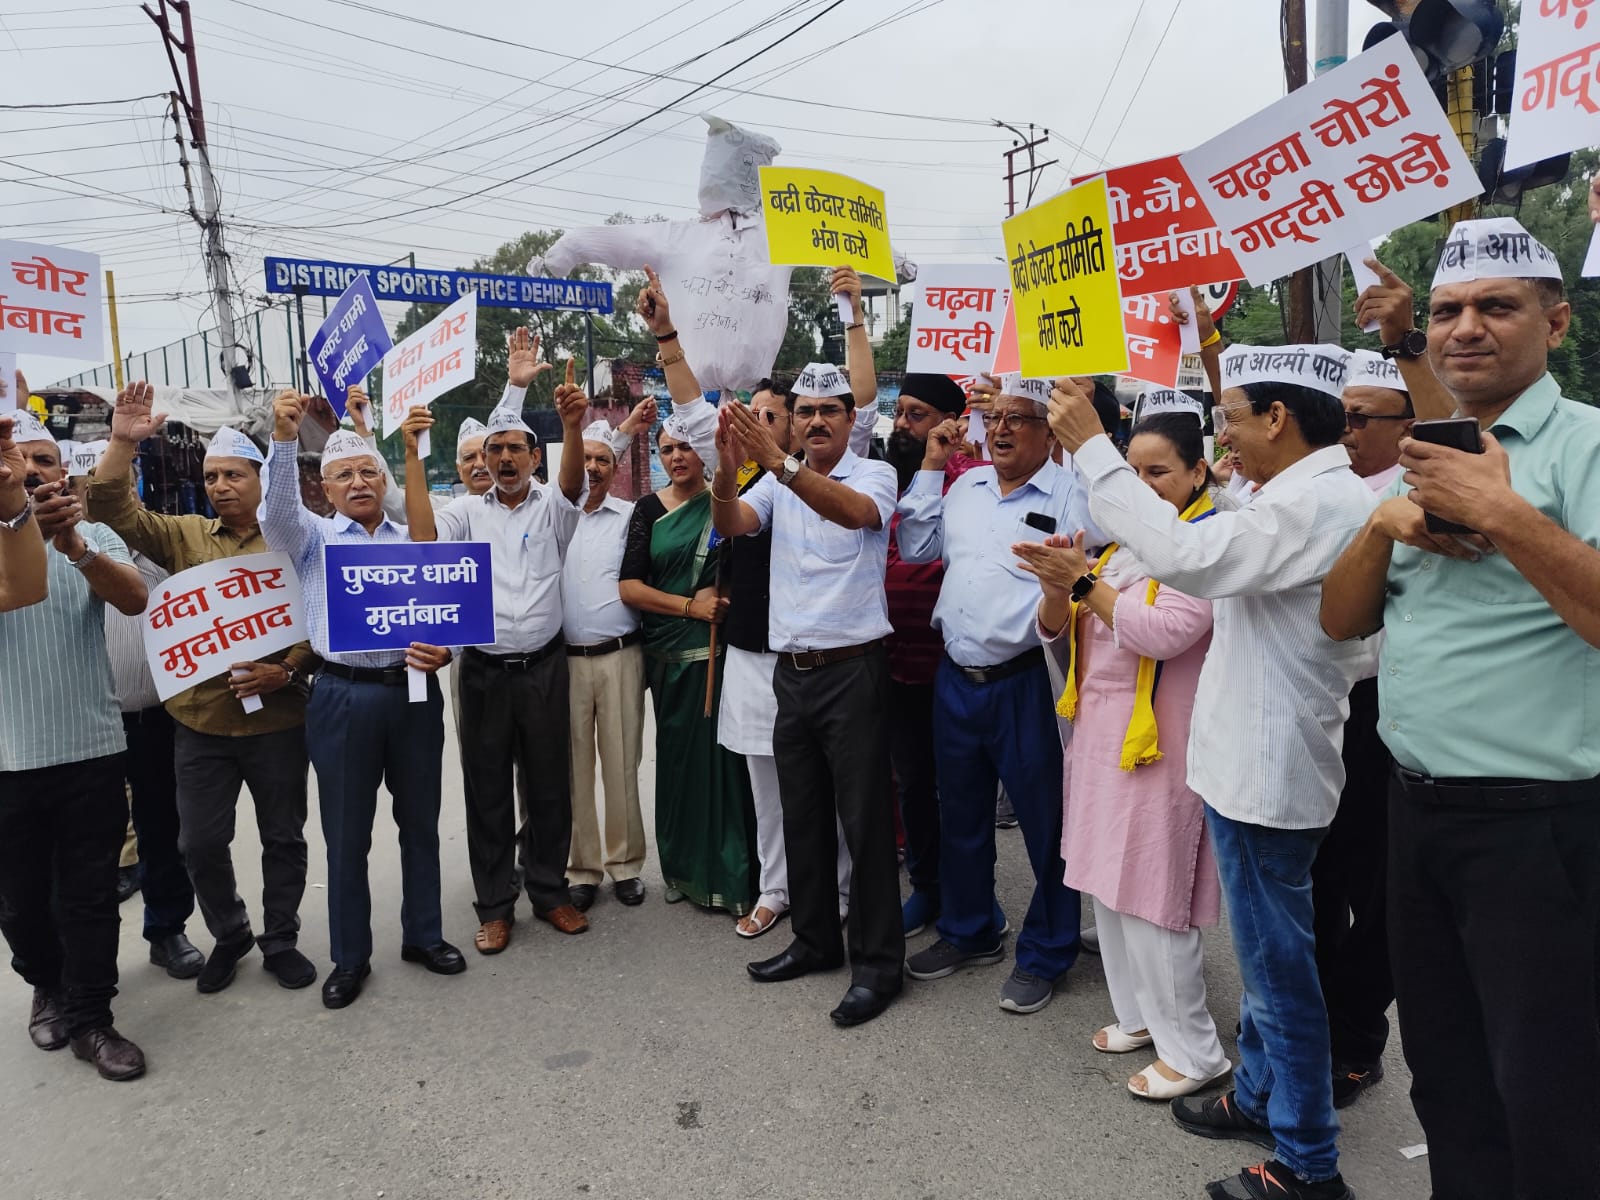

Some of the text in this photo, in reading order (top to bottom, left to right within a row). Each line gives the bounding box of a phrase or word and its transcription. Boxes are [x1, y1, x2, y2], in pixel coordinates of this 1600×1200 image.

[1208, 64, 1411, 201] चढ़वा चोरों
[1344, 132, 1451, 204] छोड़ो
[769, 183, 801, 215] बद्री
[804, 185, 846, 218] केदार
[812, 220, 869, 259] भंग करो
[1116, 223, 1231, 280] मुर्दाबा
[1486, 233, 1533, 263] आम
[11, 256, 89, 296] चोर
[377, 270, 451, 297] SPORTS
[456, 276, 518, 302] OFFICE
[521, 281, 608, 308] DEHRADUN
[1012, 242, 1031, 297] बद्री
[1027, 240, 1057, 289] केदार
[925, 286, 996, 320] चढ़वा
[1038, 298, 1058, 351] भंग
[1057, 295, 1083, 348] करो
[316, 294, 367, 374] पुष्कर धामी
[389, 311, 468, 379] चंदा चोर
[1250, 348, 1309, 373] आदमी
[332, 334, 369, 391] मुर्दाबाद
[389, 348, 464, 419] मुर्दाबाद
[1366, 360, 1400, 380] आम
[149, 567, 286, 630] चंदा चोर
[341, 556, 479, 595] पुष्कर धामी
[159, 603, 293, 679] मुर्दाबाद
[365, 598, 461, 635] मुर्दाबाद
